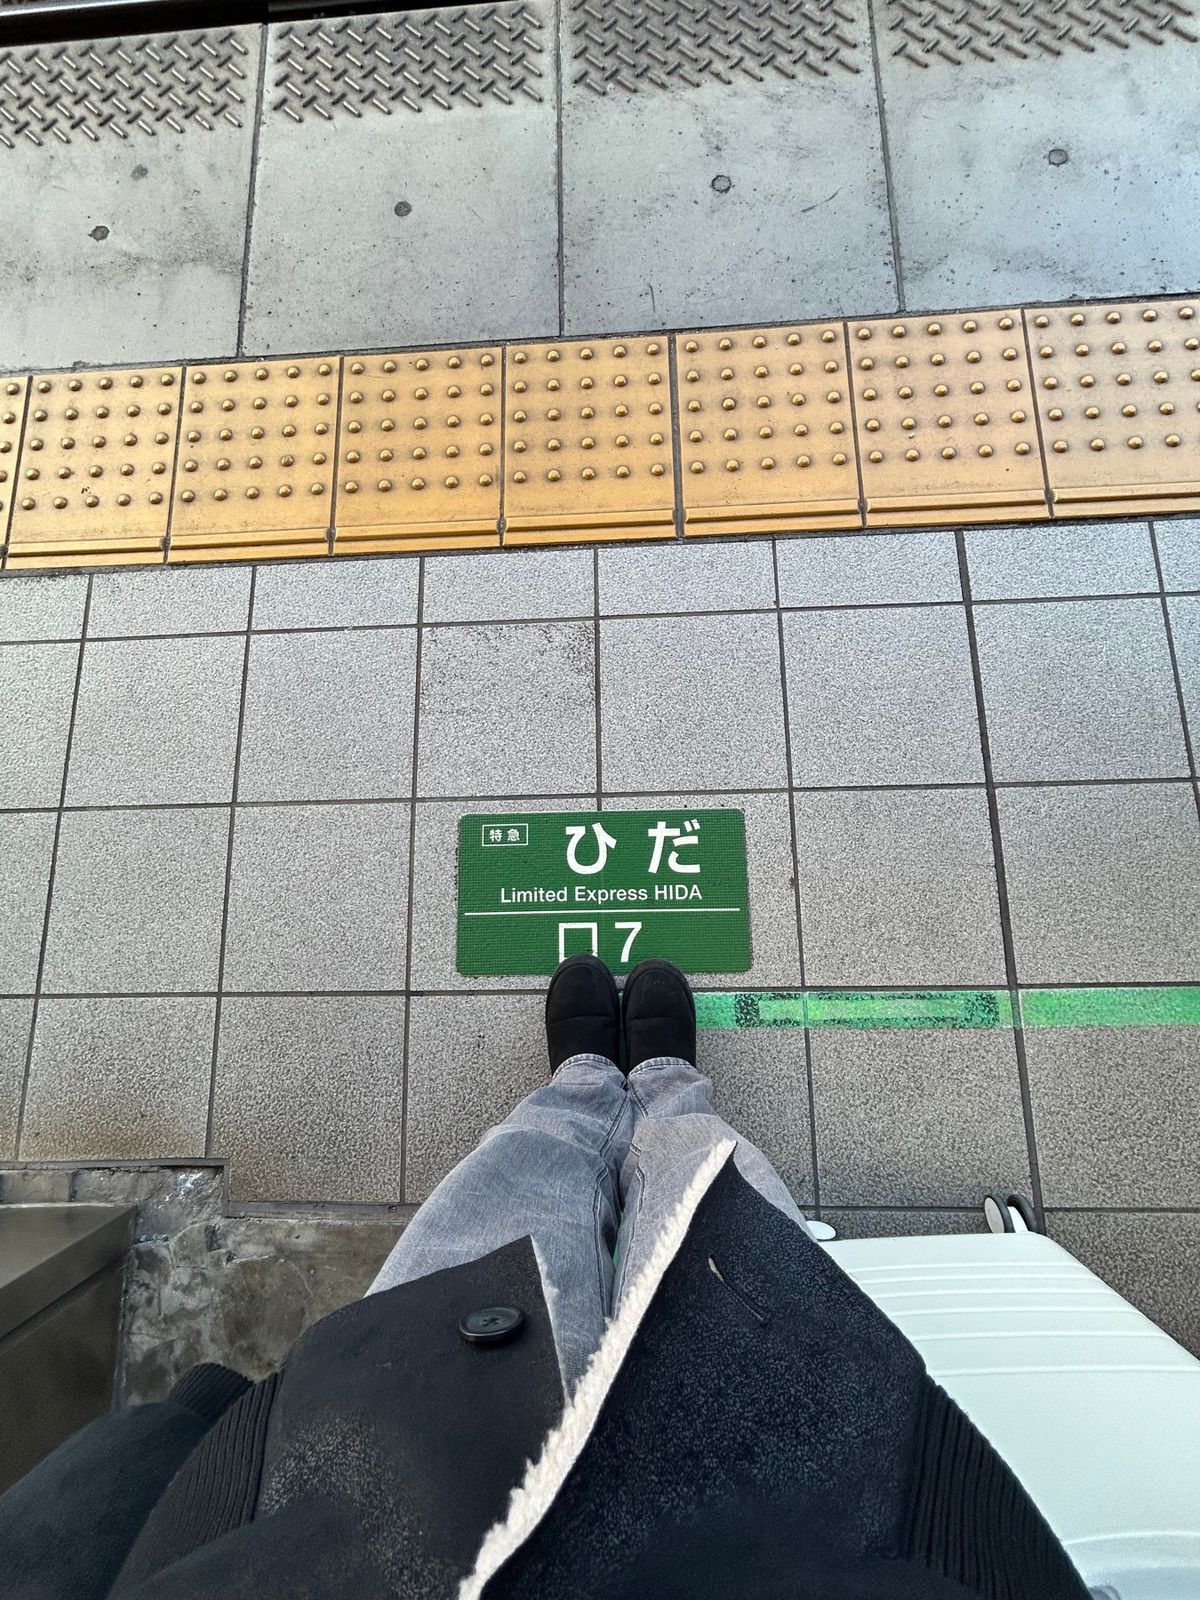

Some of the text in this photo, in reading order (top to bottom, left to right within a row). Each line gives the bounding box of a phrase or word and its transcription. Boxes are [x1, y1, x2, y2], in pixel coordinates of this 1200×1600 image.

[489, 828, 521, 843] 特急
[565, 818, 702, 875] ひだ
[500, 884, 703, 905] Limited Express HIDA
